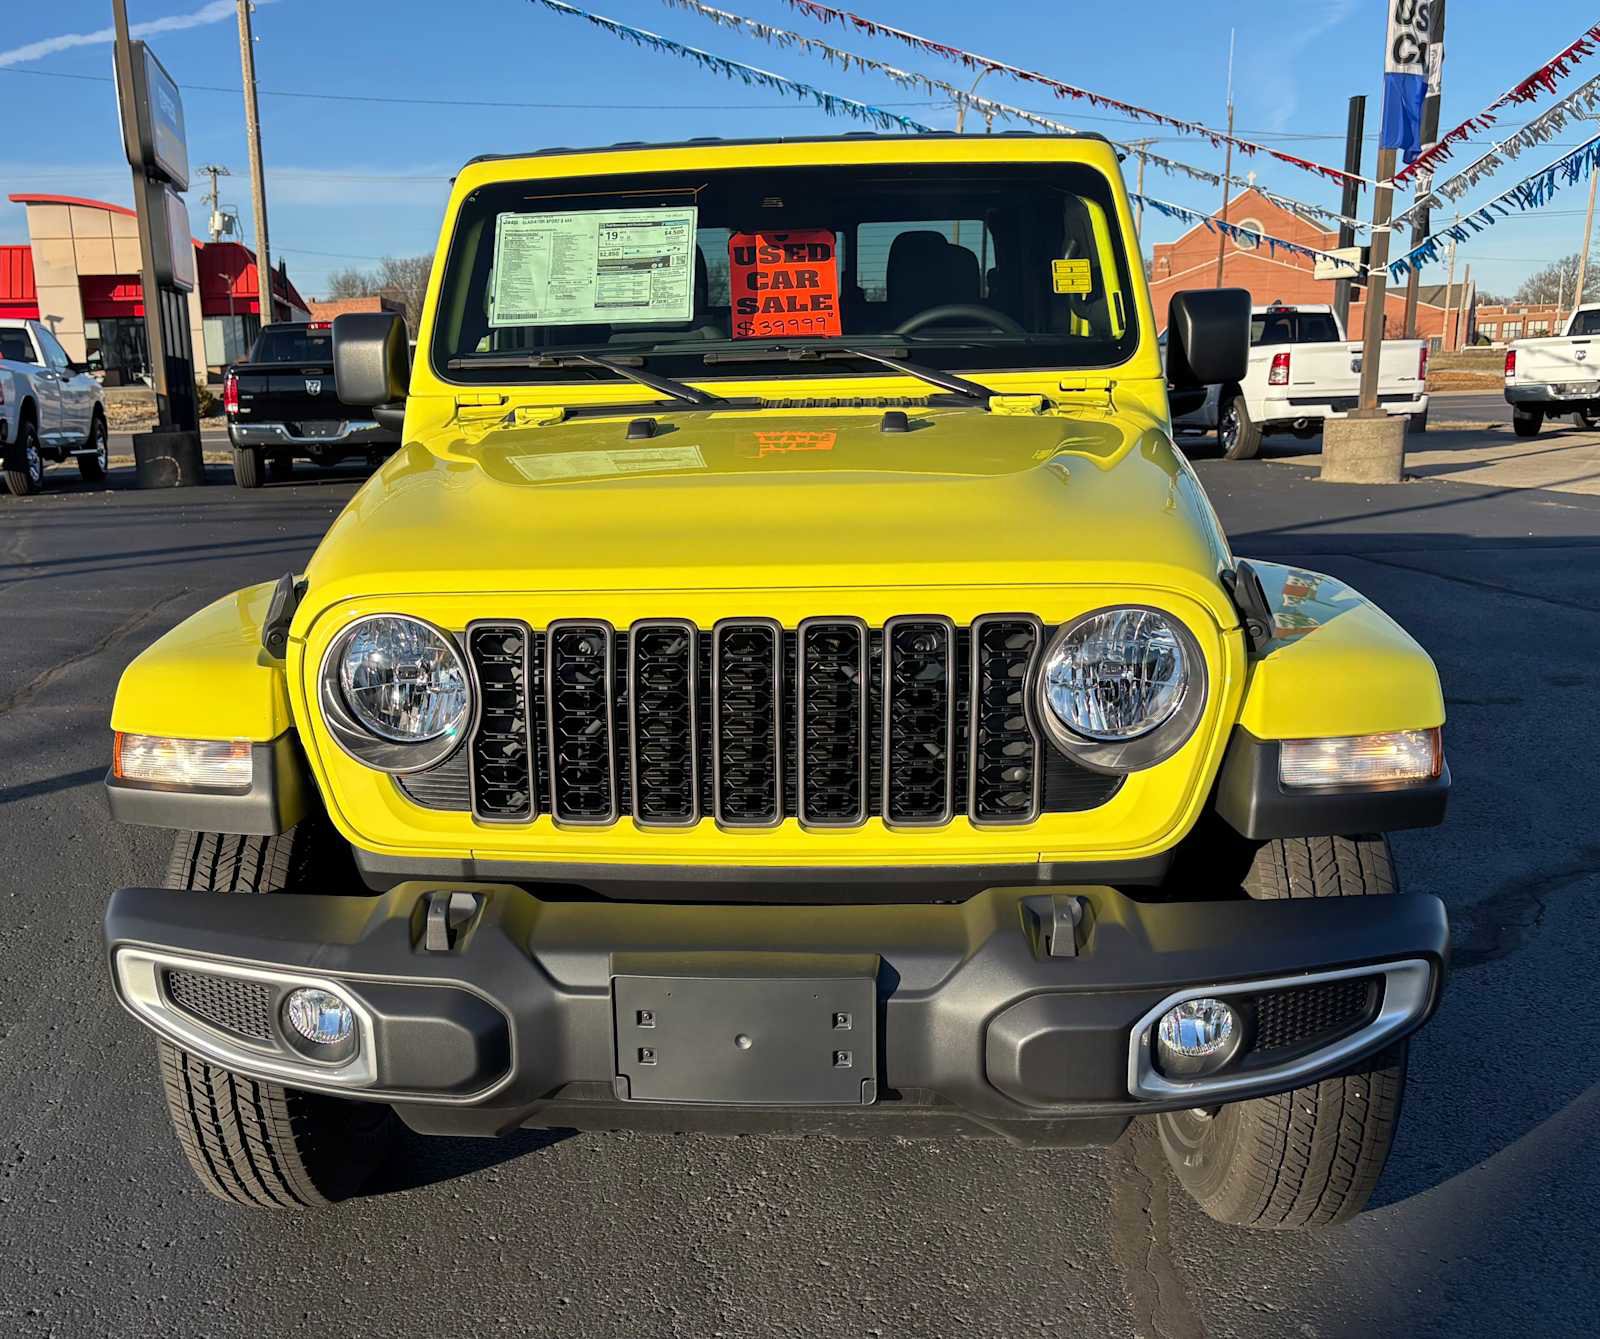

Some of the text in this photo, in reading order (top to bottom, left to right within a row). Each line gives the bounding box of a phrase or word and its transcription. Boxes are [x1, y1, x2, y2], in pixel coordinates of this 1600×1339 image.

[605, 231, 618, 240] 19
[733, 243, 831, 266] USED
[746, 269, 820, 291] CAR
[736, 294, 833, 315] SALE
